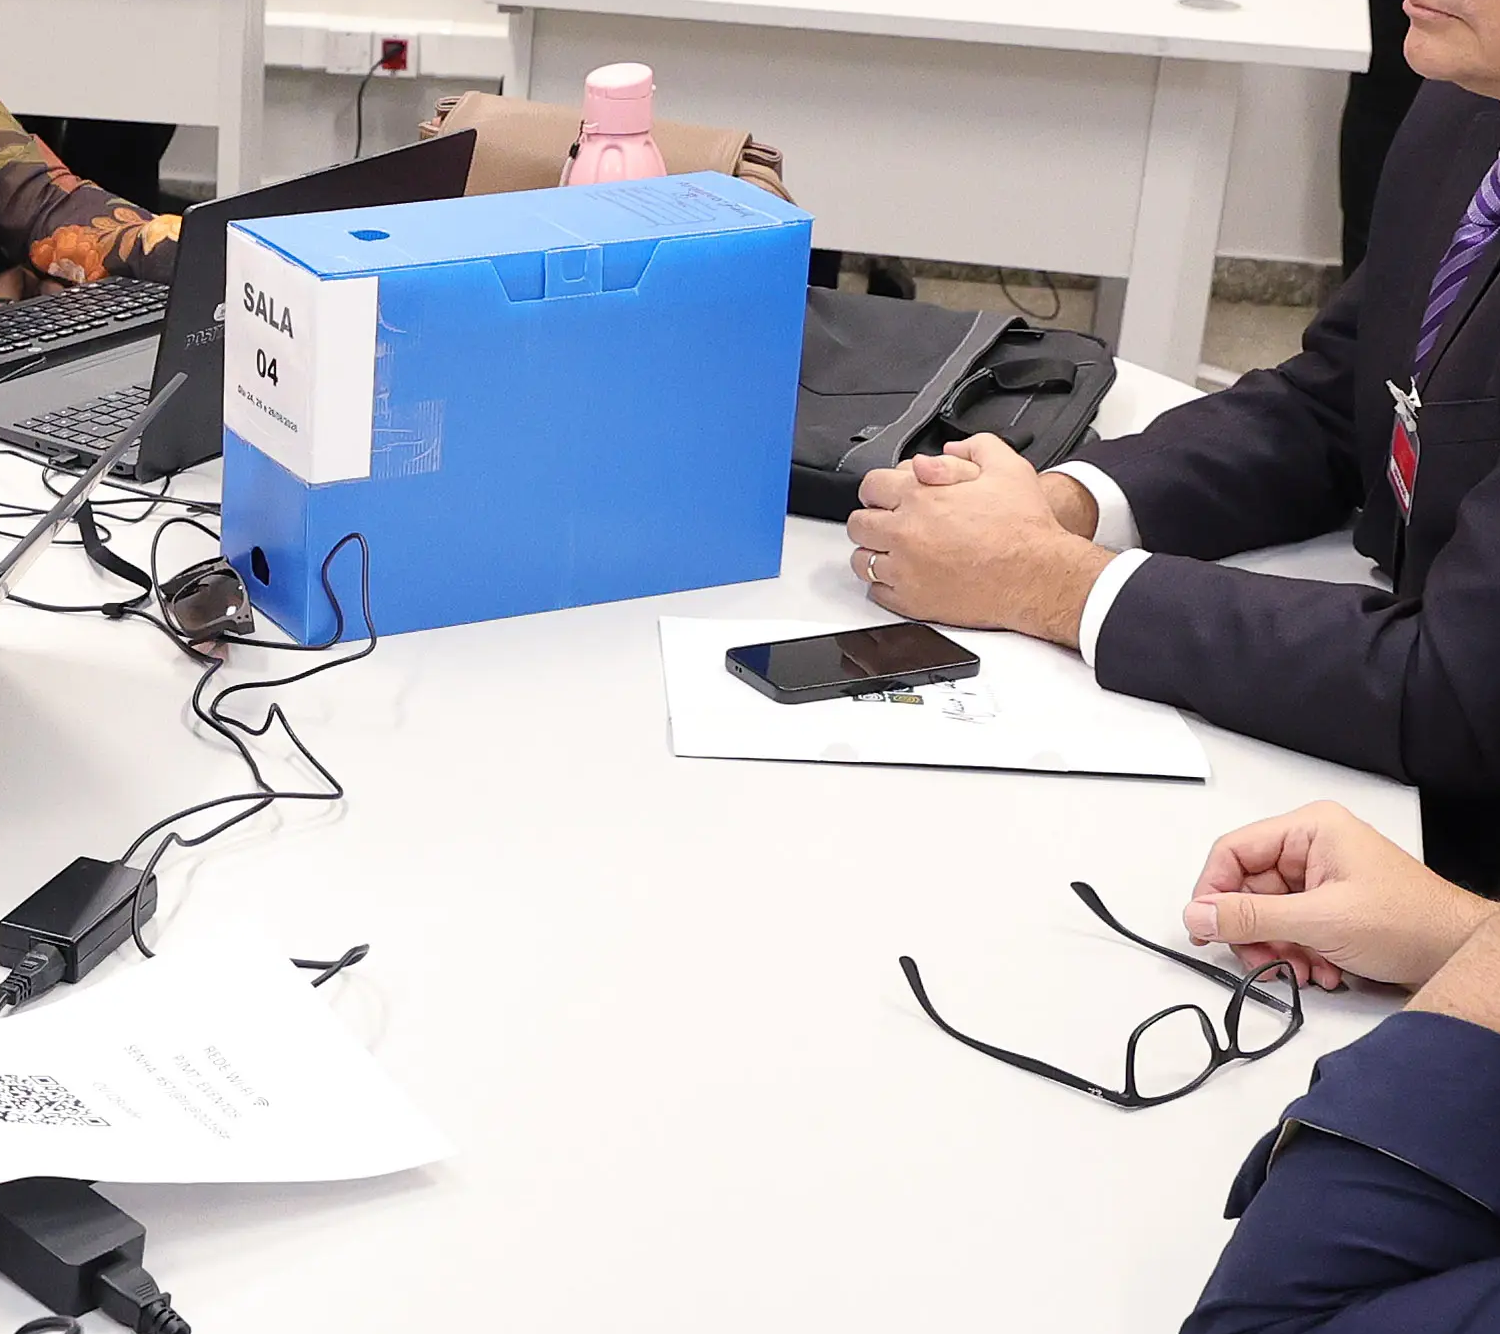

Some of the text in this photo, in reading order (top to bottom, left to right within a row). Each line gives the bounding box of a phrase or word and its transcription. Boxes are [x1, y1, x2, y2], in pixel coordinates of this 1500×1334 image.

[243, 282, 294, 339] SALA
[256, 348, 279, 387] 04
[204, 1045, 232, 1072] REDE
